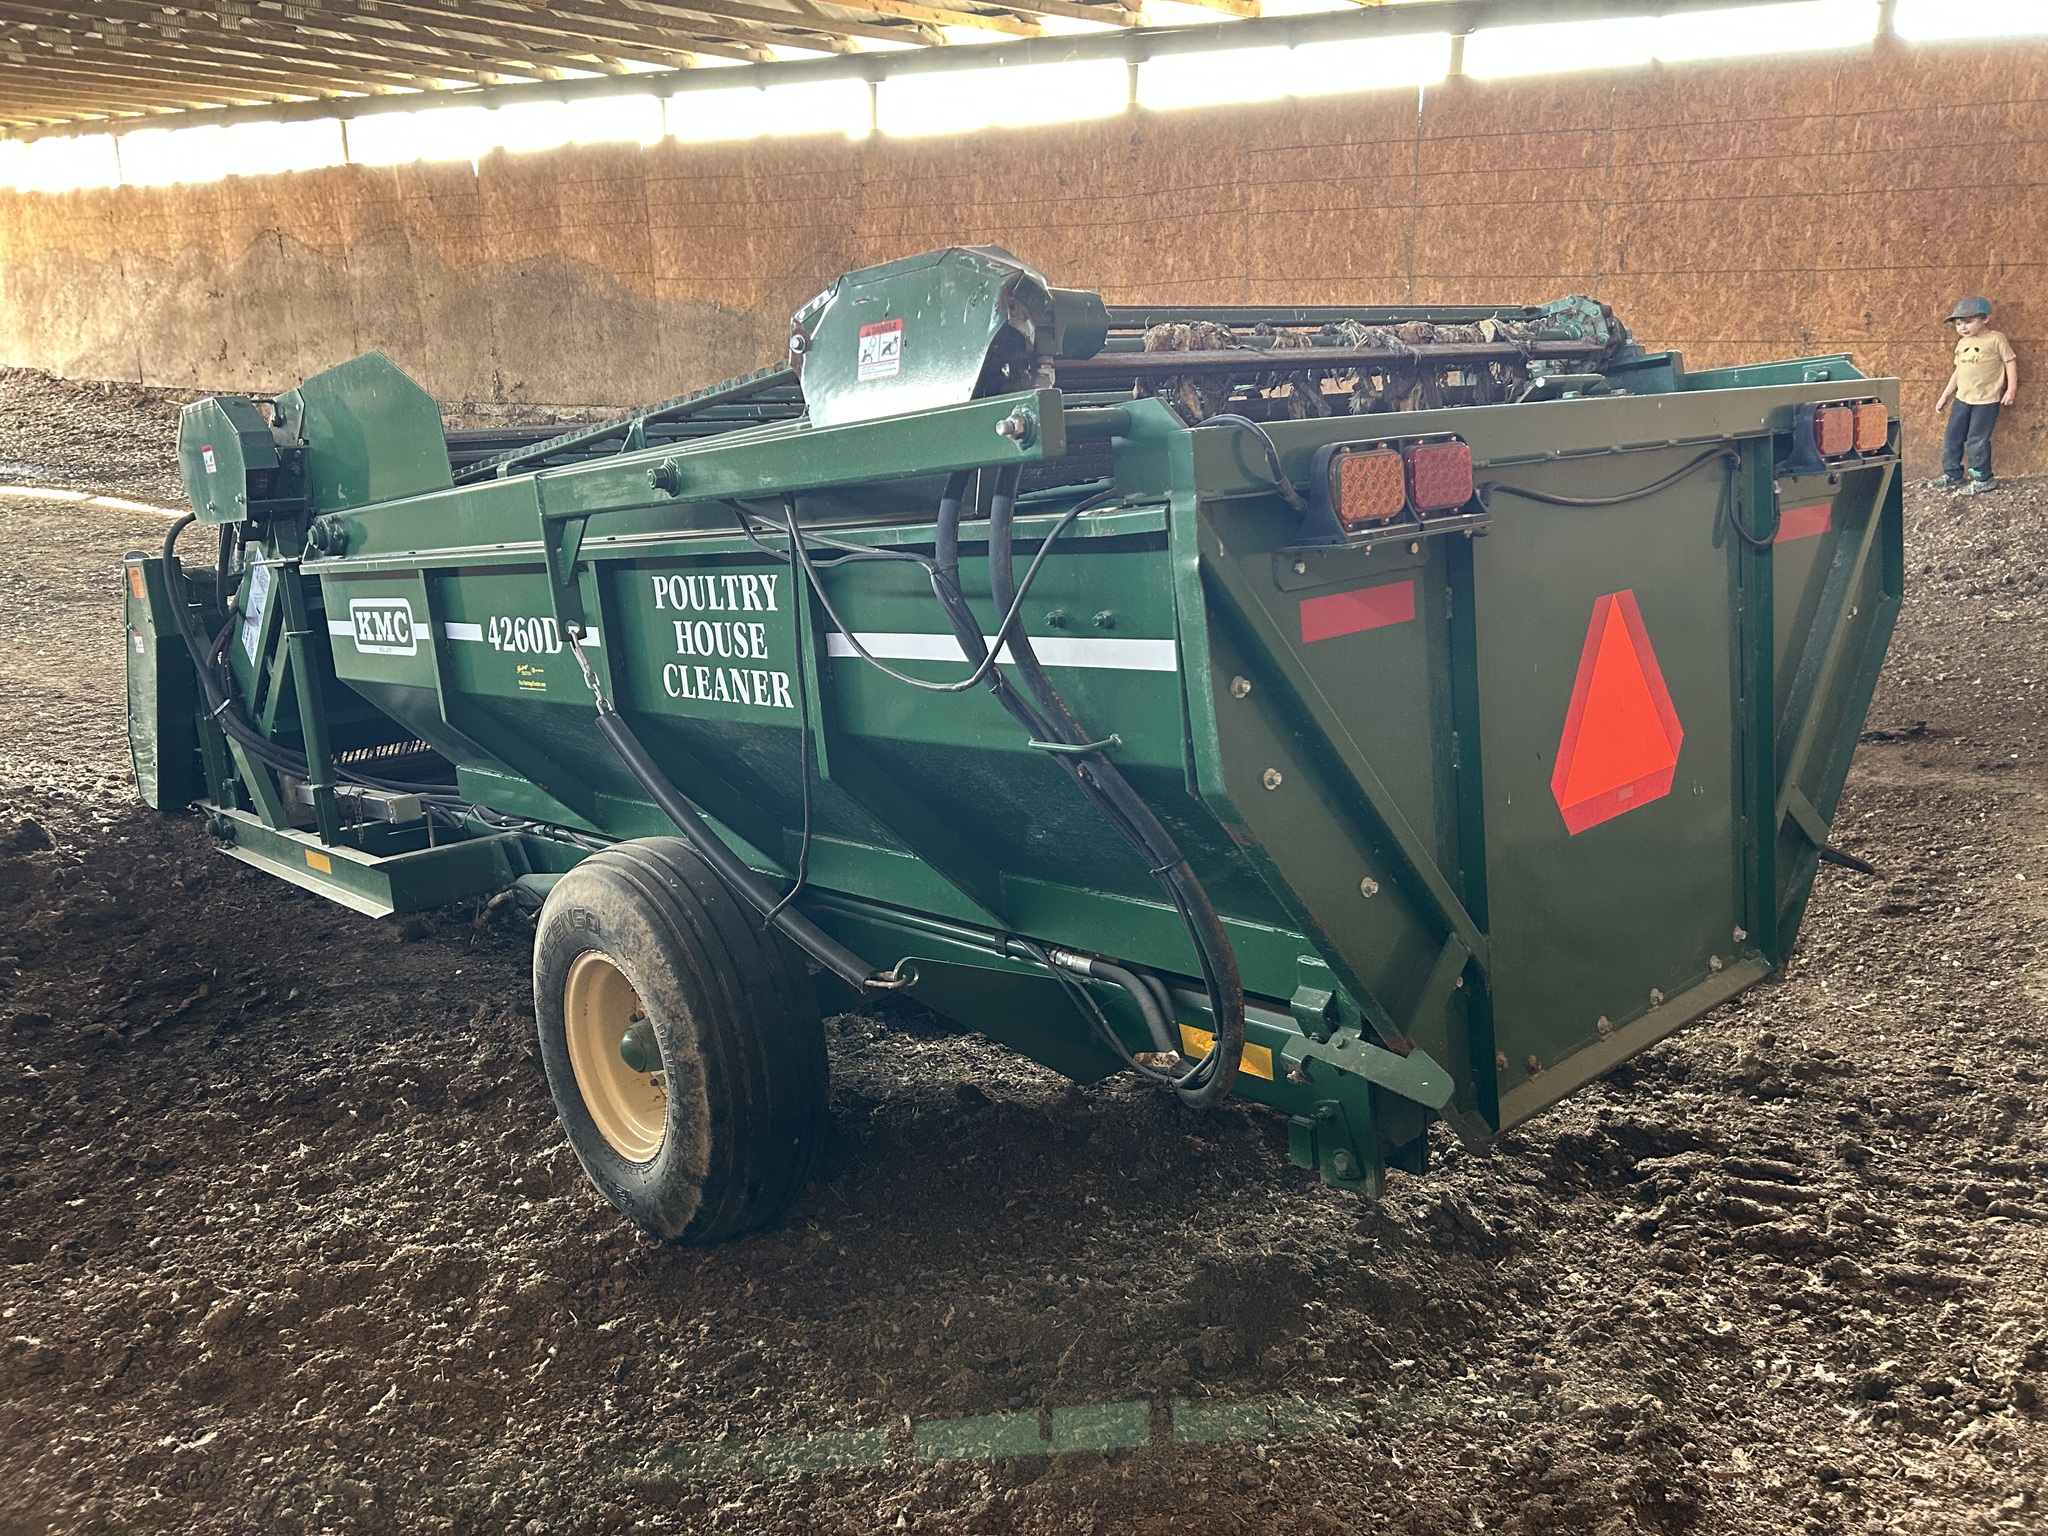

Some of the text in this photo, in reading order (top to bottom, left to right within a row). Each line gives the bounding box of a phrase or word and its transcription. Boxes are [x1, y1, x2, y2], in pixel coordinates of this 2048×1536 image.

[872, 322, 897, 335] DANGER
[651, 574, 779, 612] POULTRY
[355, 610, 409, 644] KMC
[487, 616, 563, 655] 4260D
[672, 620, 769, 660] HOUSE
[662, 663, 795, 709] CLEANER
